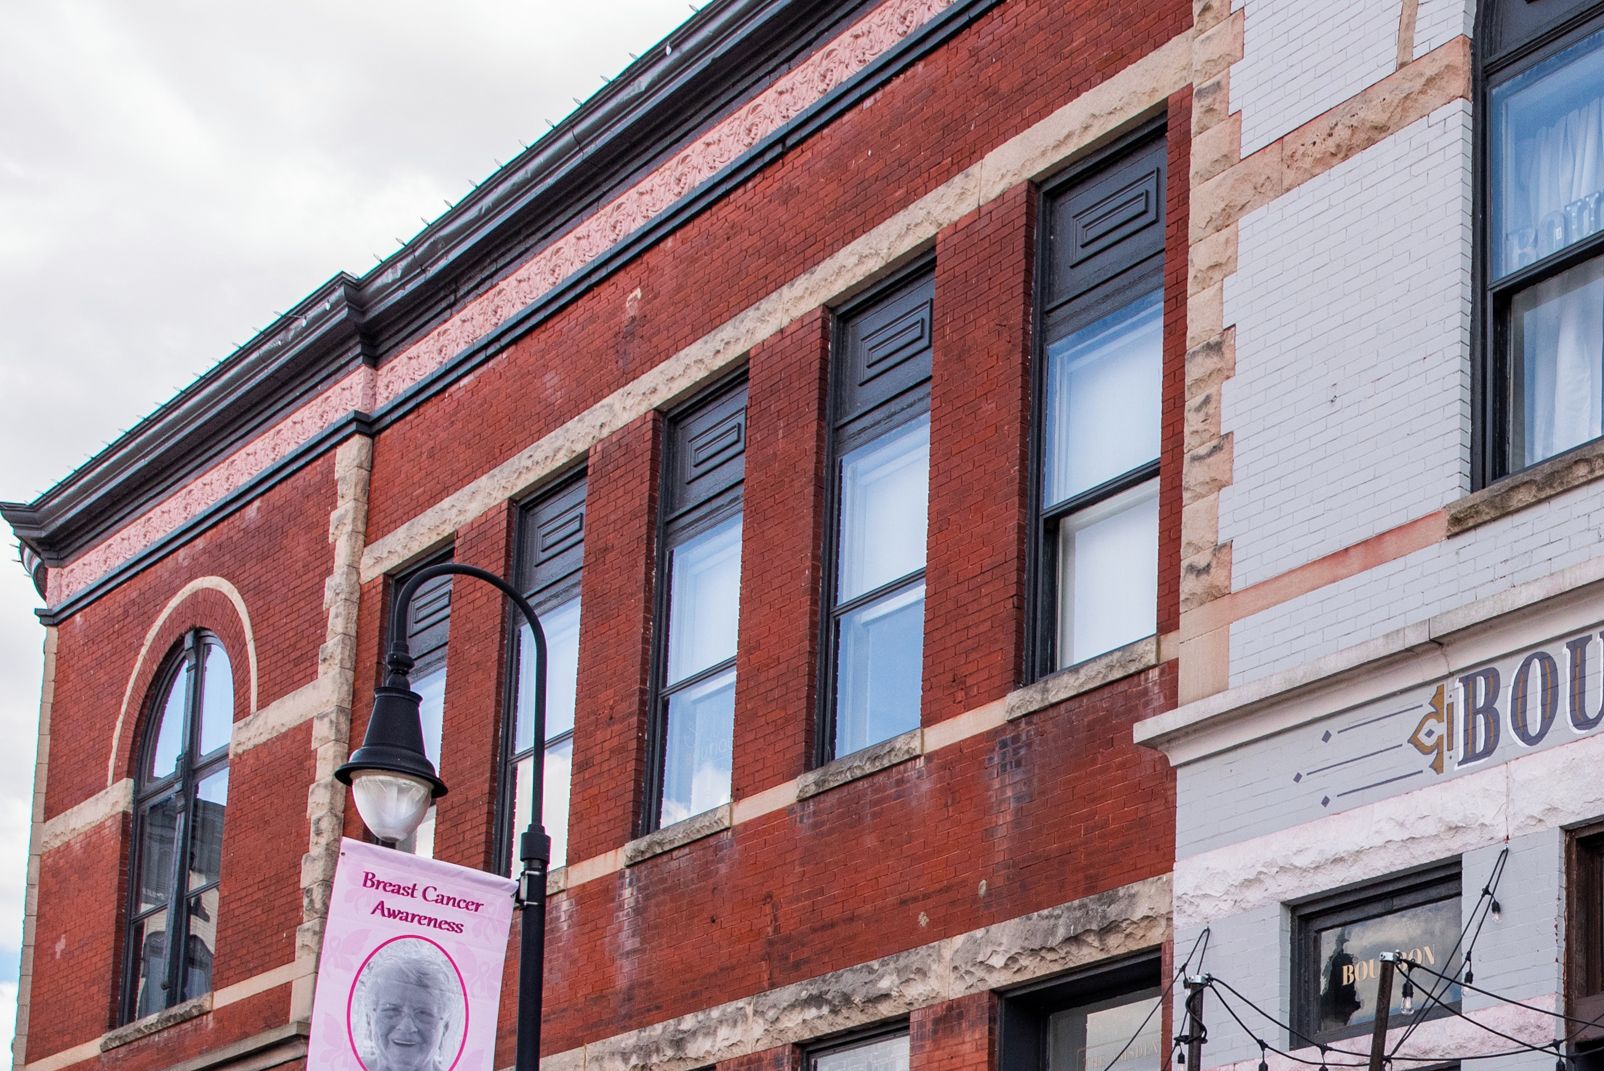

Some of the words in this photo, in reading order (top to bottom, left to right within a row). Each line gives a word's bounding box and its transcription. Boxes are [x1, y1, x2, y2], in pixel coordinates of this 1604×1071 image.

[361, 870, 418, 900] Breast
[421, 885, 485, 914] Cancer
[370, 899, 465, 935] Awareness
[1342, 945, 1434, 986] BOUBON
